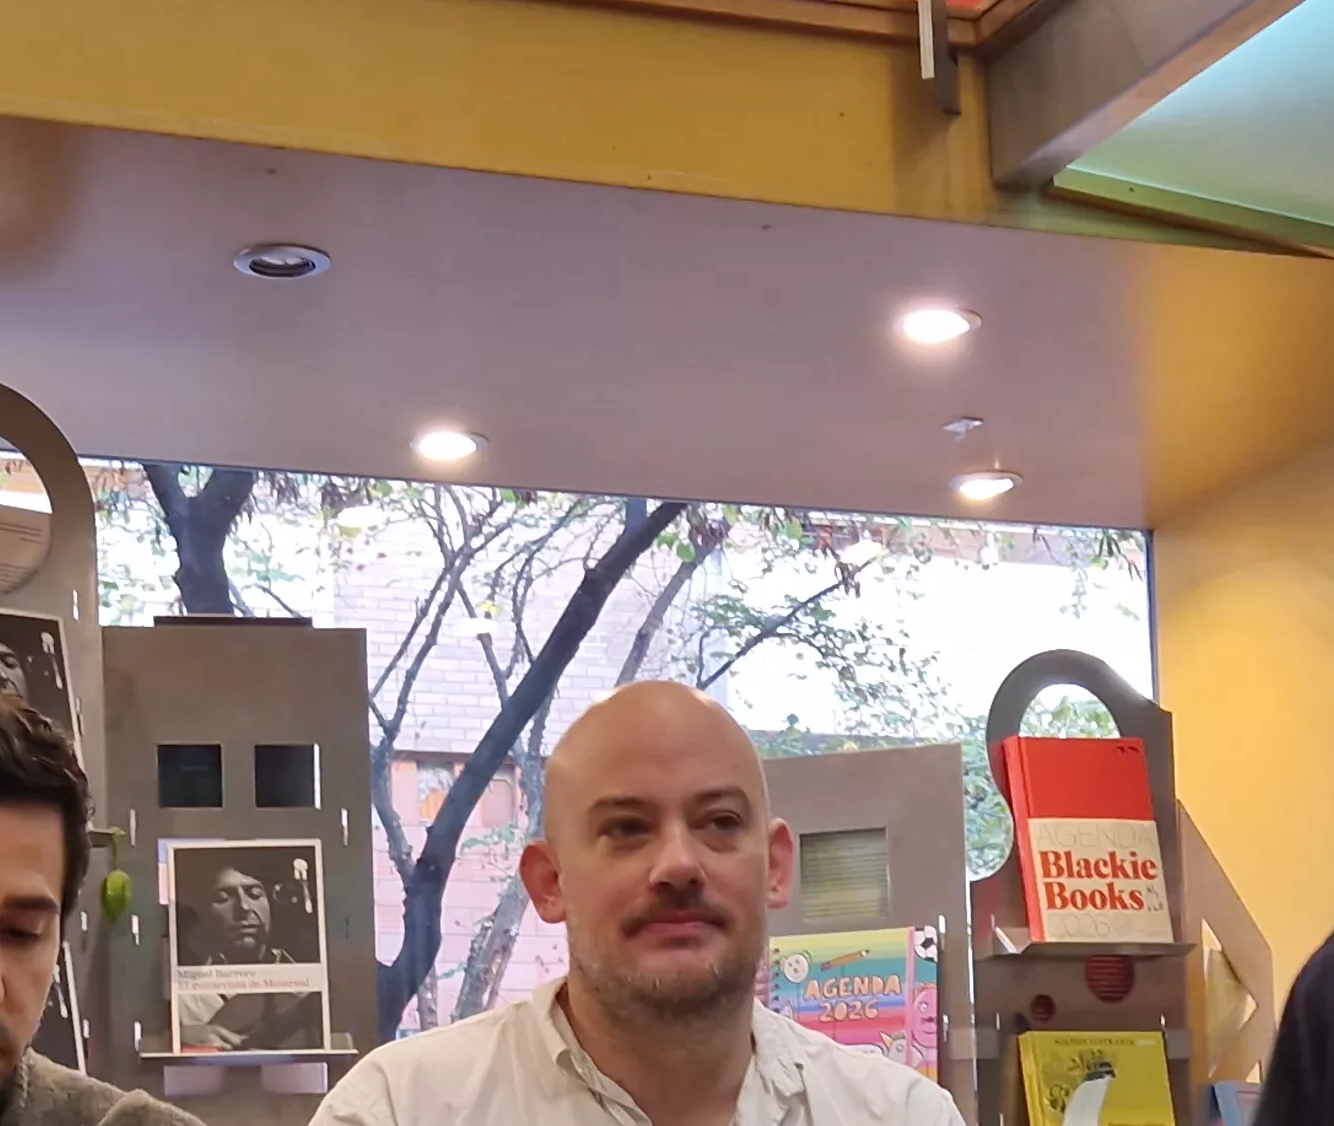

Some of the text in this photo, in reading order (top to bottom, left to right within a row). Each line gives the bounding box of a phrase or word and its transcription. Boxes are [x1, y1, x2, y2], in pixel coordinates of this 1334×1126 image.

[1037, 849, 1159, 881] Blackie
[1042, 880, 1146, 912] Books
[803, 973, 903, 1001] AGENDA
[818, 998, 880, 1023] 2026
